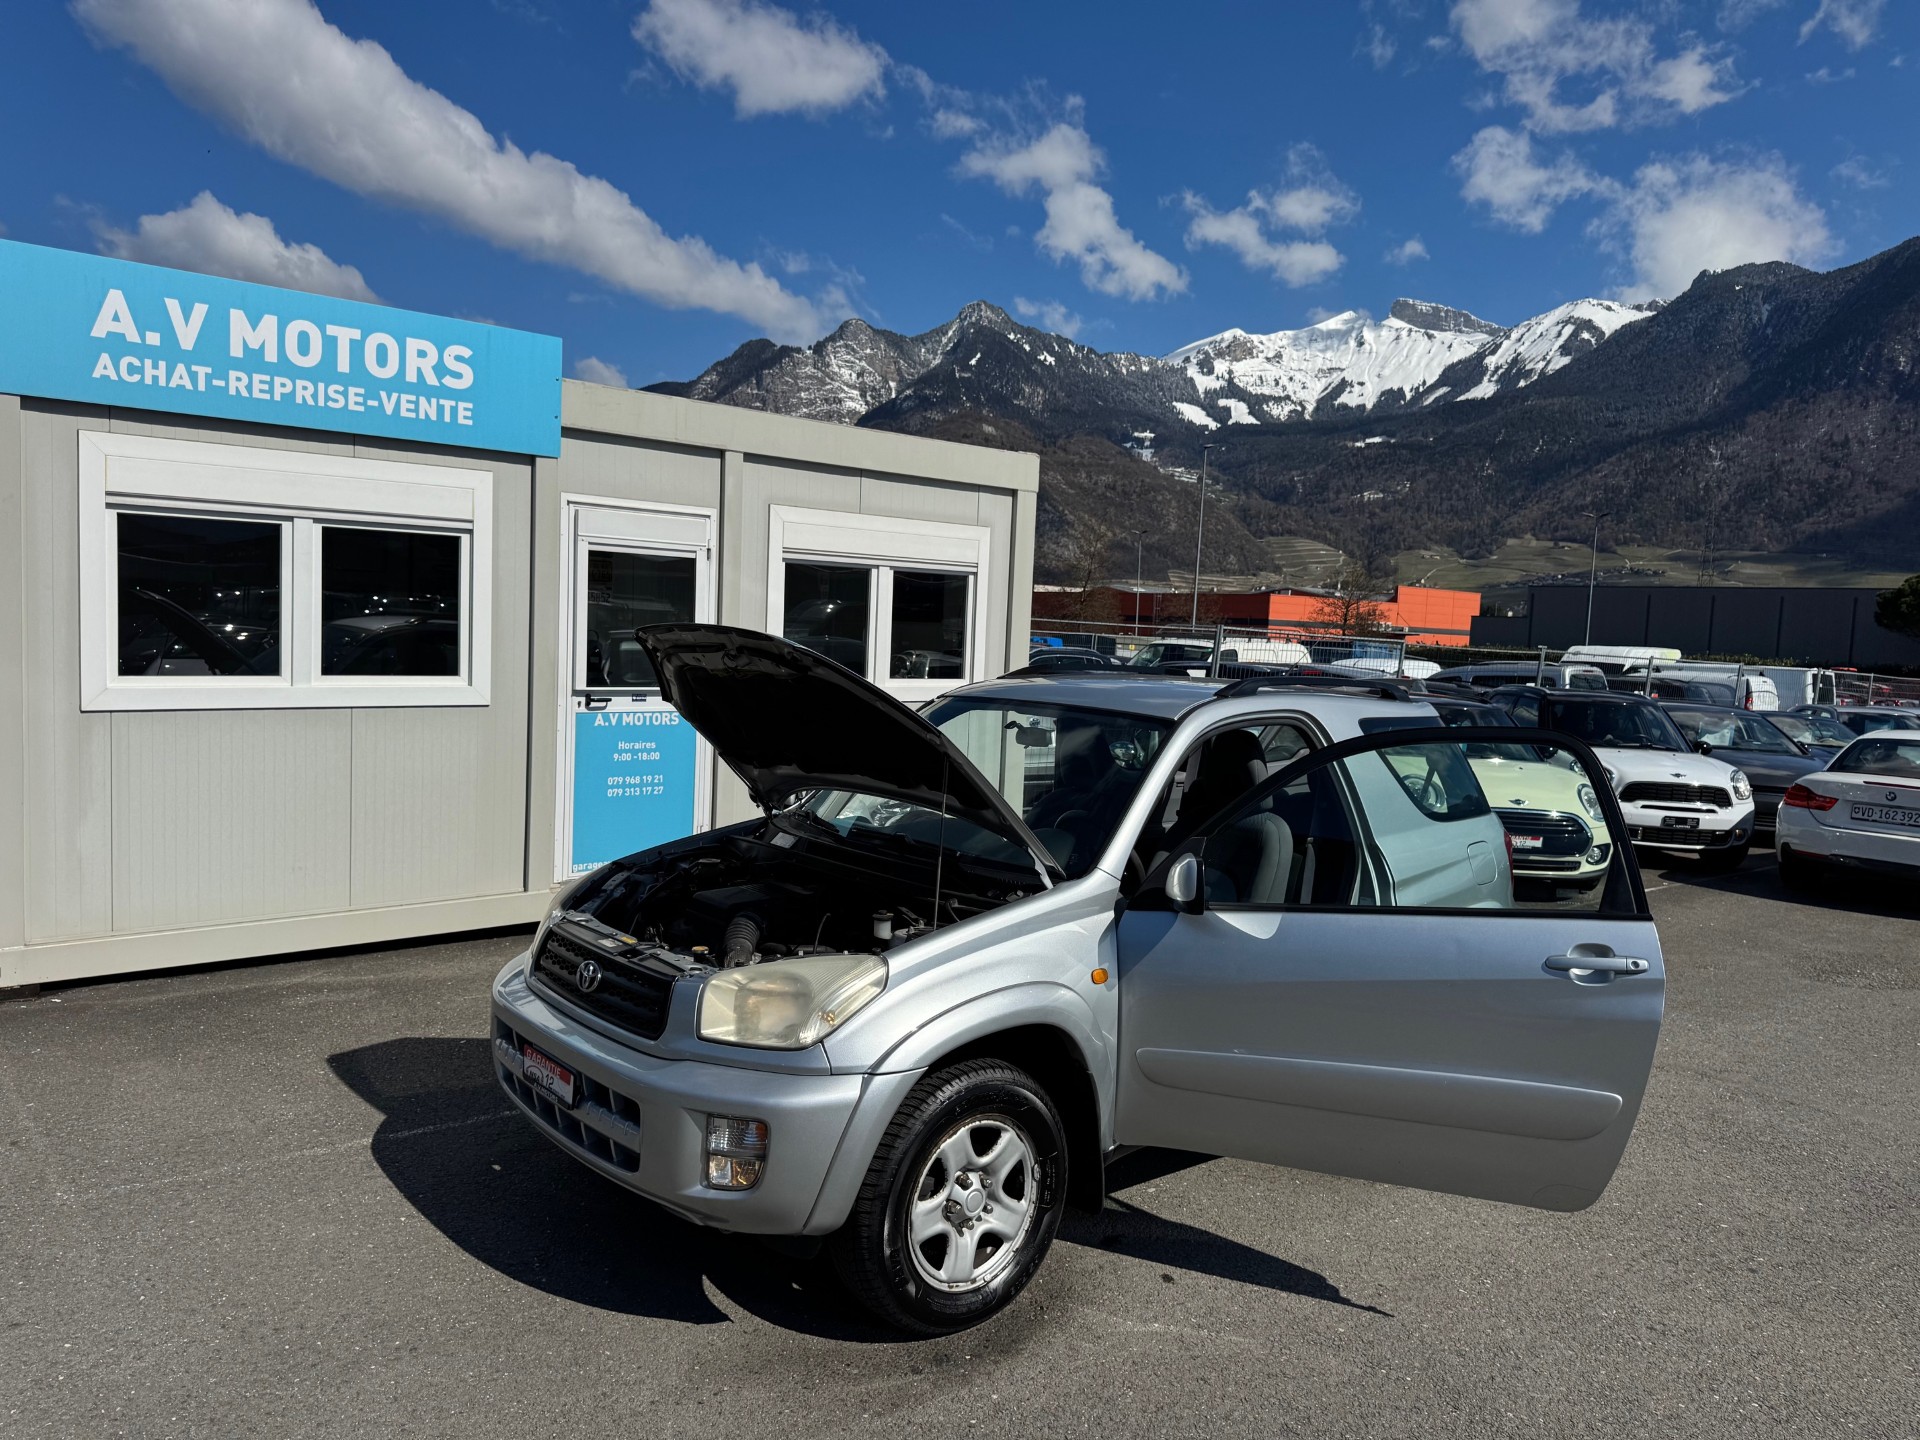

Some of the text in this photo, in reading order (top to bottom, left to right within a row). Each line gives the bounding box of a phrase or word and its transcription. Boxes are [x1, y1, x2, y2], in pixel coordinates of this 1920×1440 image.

[90, 288, 474, 390] A.V MOTORS
[92, 352, 474, 426] ACHAT-REPRISE-VENTE
[594, 713, 680, 727] A.V MOTORS
[618, 741, 656, 749] Horaires
[613, 753, 632, 761] 9:00
[607, 774, 663, 785] 079 968 19 21
[607, 786, 664, 797] 079 313 17 27
[573, 861, 611, 873] garagea
[526, 1049, 561, 1078] GARANTIE
[545, 1073, 555, 1090] 12
